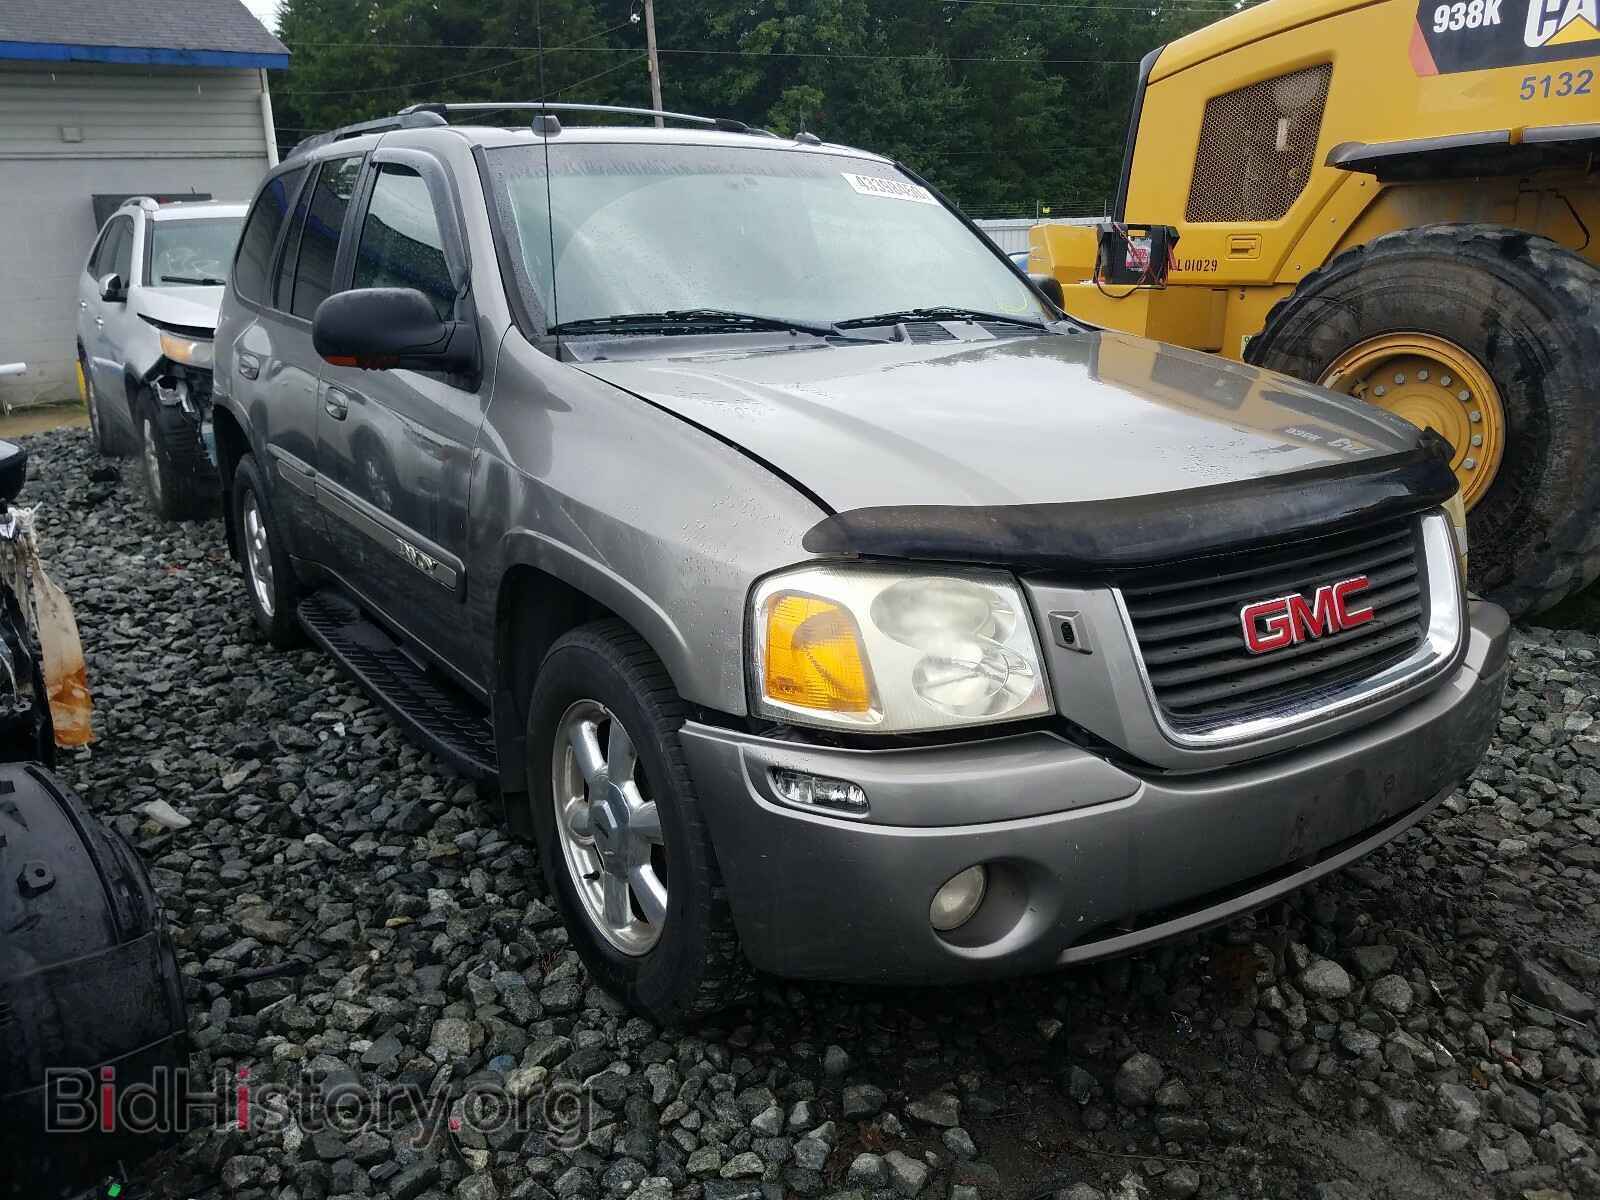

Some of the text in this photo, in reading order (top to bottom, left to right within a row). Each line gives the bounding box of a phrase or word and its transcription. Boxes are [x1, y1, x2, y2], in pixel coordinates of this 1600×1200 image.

[1433, 0, 1502, 33] 938K
[1519, 69, 1594, 101] 5132
[1240, 575, 1375, 655] GMC
